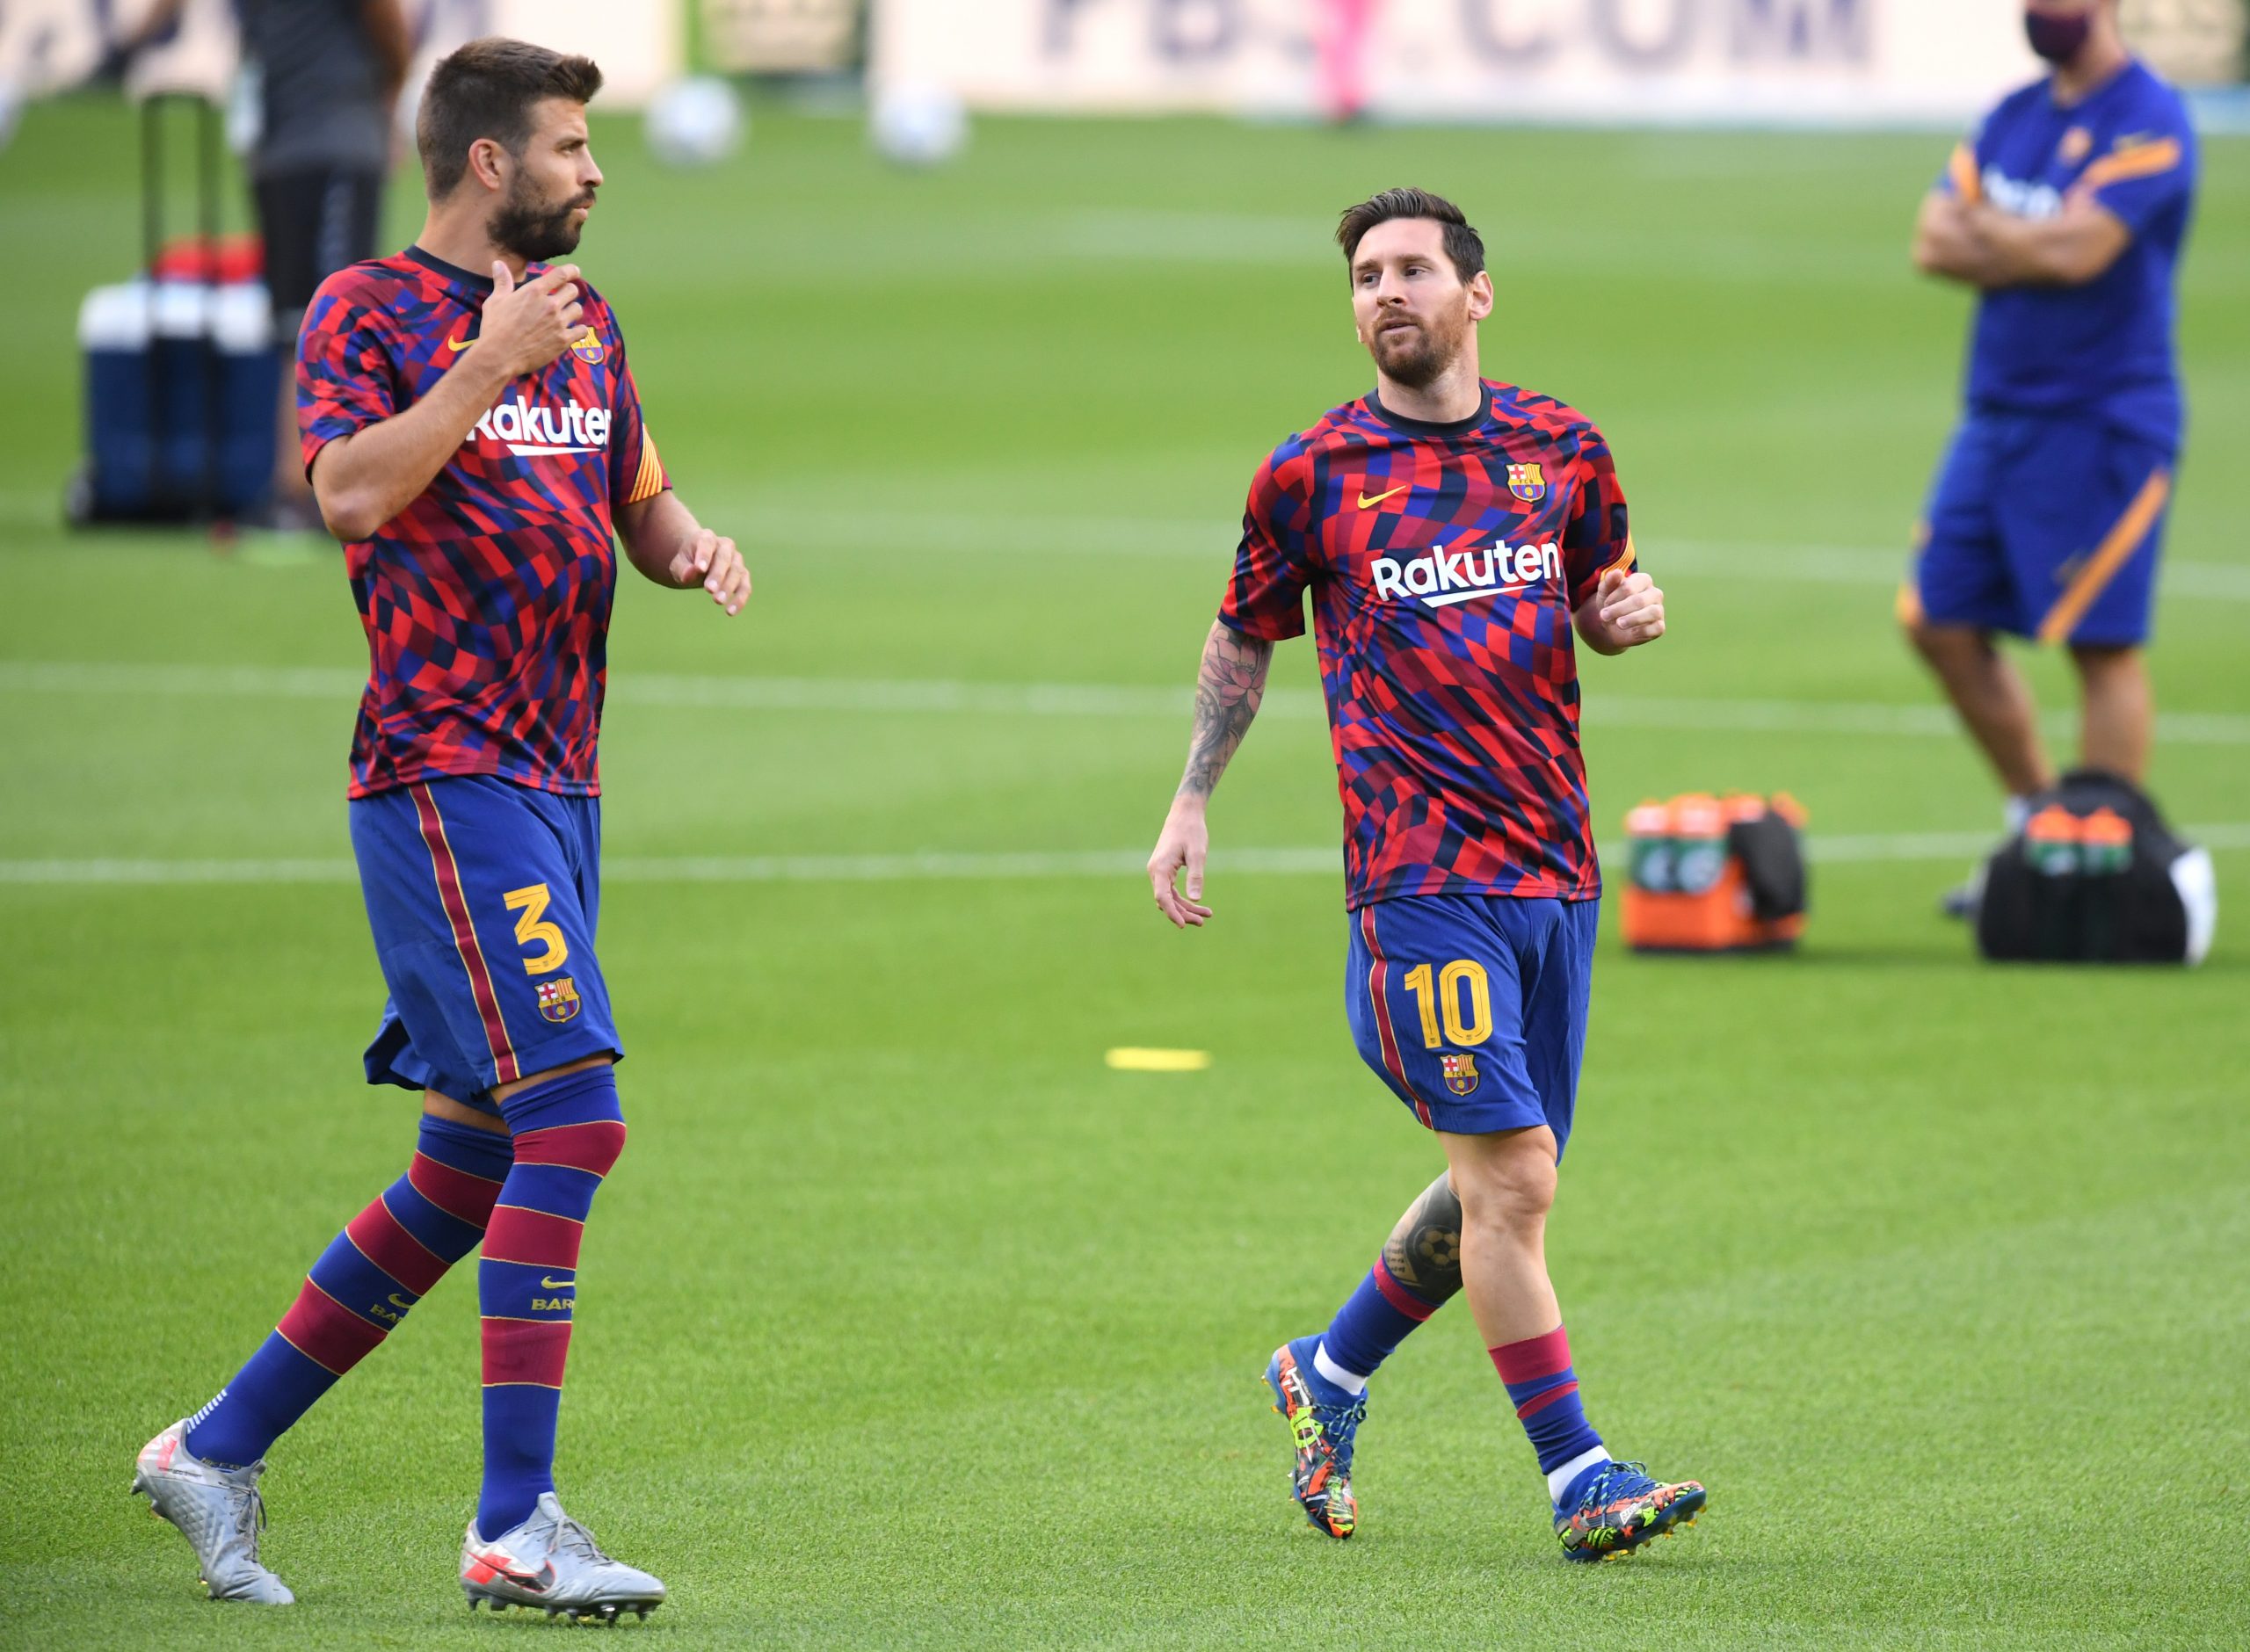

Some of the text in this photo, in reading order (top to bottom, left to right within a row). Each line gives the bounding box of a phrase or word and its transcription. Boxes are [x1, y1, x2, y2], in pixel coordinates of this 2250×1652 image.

[1370, 539, 1561, 602] Rakuten
[502, 882, 569, 975] 3
[1404, 959, 1493, 1049] 10
[369, 1303, 402, 1322] BA
[531, 1297, 576, 1311] BAR
